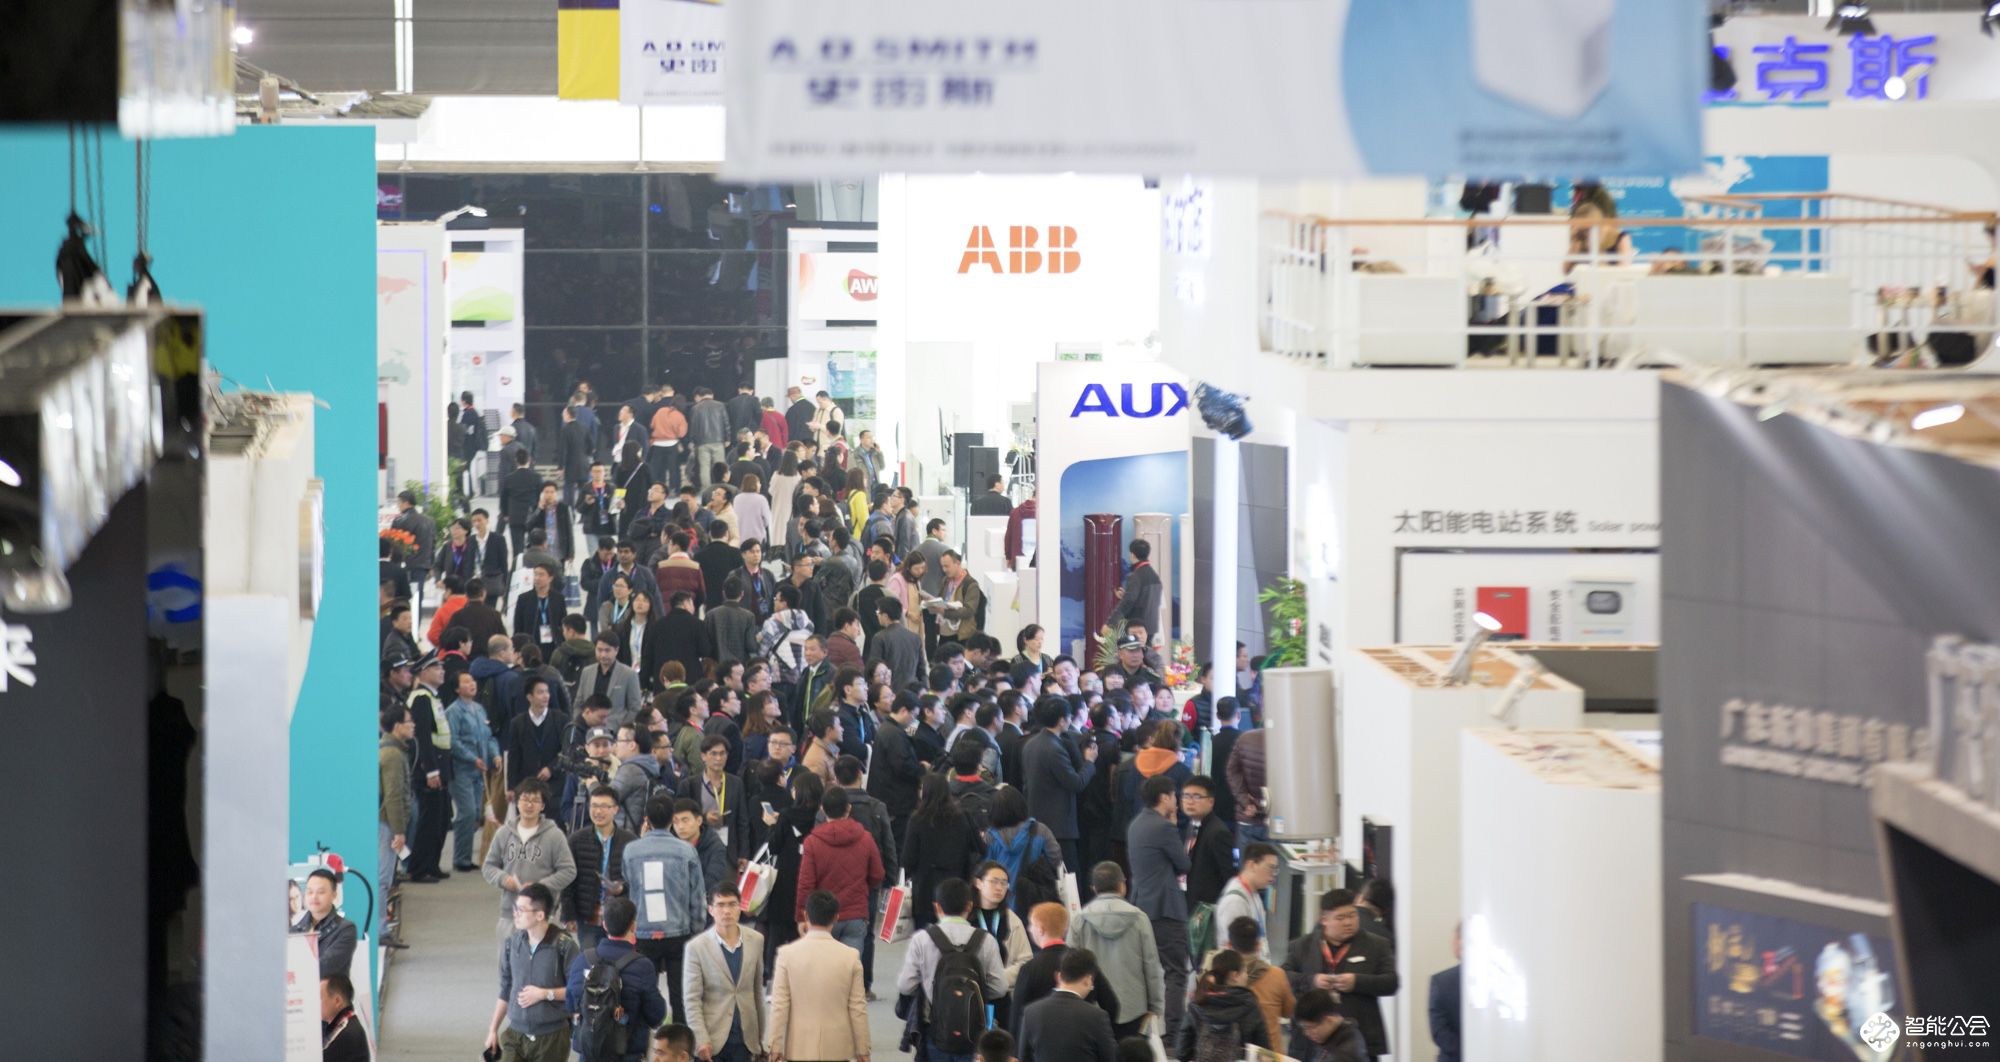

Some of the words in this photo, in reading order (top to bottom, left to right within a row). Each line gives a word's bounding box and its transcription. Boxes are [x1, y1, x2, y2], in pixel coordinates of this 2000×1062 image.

[1702, 33, 1937, 99] 克斯
[957, 225, 1082, 274] ABB
[1393, 510, 1579, 534] 太阳能电站系统
[508, 841, 542, 863] GAP
